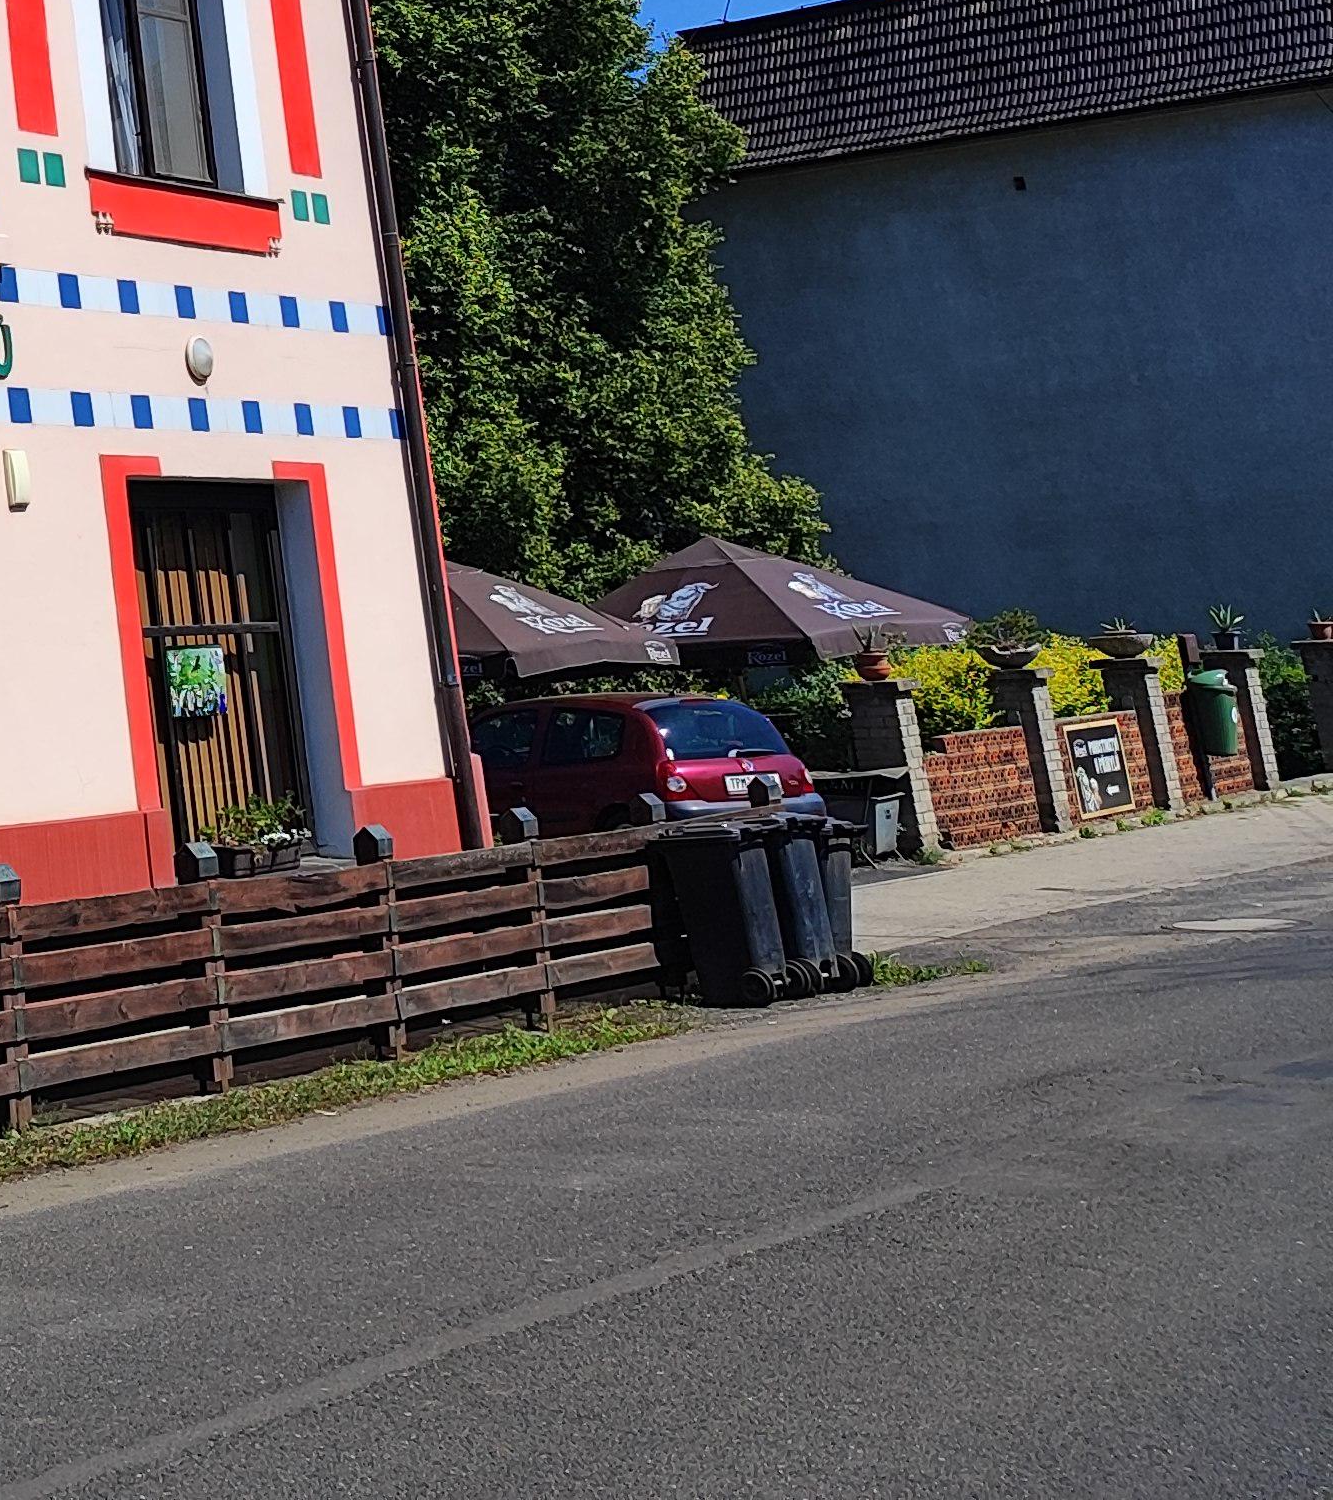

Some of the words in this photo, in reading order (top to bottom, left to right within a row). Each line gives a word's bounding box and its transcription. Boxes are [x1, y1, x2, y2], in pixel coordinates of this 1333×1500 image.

[813, 600, 902, 620] Kozel
[515, 613, 605, 635] Kozel
[746, 650, 787, 665] Kozel
[461, 662, 484, 677] zel
